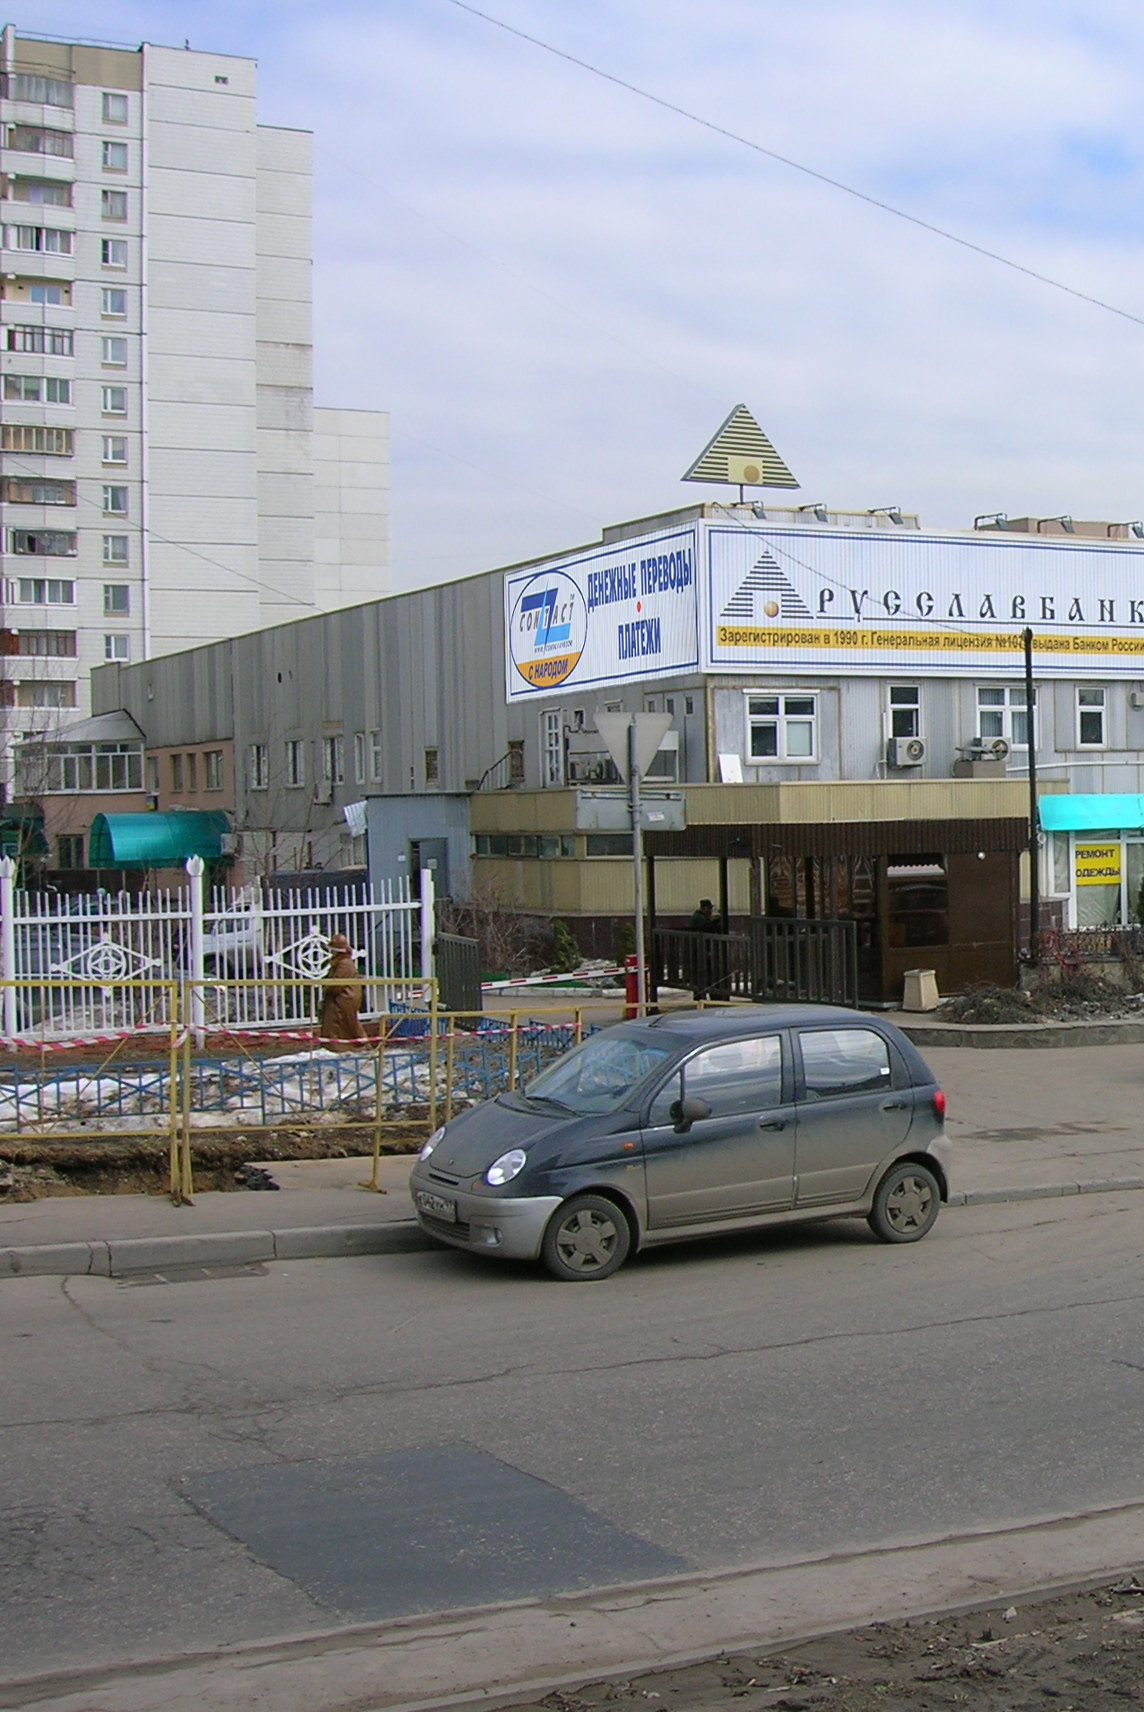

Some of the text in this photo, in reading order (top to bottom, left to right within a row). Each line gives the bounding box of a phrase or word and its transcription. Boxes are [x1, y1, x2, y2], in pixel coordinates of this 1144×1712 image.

[587, 548, 692, 613] ДЕНЕЖНЫЕ ПЕРЕВОДЫ
[519, 602, 574, 632] CONTACT
[618, 617, 661, 660] ПЛАТЕЖИ
[720, 627, 820, 646] Зарегистрирован
[824, 634, 830, 644] в
[833, 632, 858, 646] 1990
[861, 635, 868, 646] г.
[871, 632, 940, 649] Генеральная
[943, 637, 993, 650] лицензия
[1032, 638, 1070, 651] выдана
[1073, 637, 1109, 651] Банком
[528, 658, 568, 680] С НАРОДОМ
[1075, 849, 1115, 859] РЕМОНТ
[1075, 867, 1120, 878] ОДЕЖДЫ
